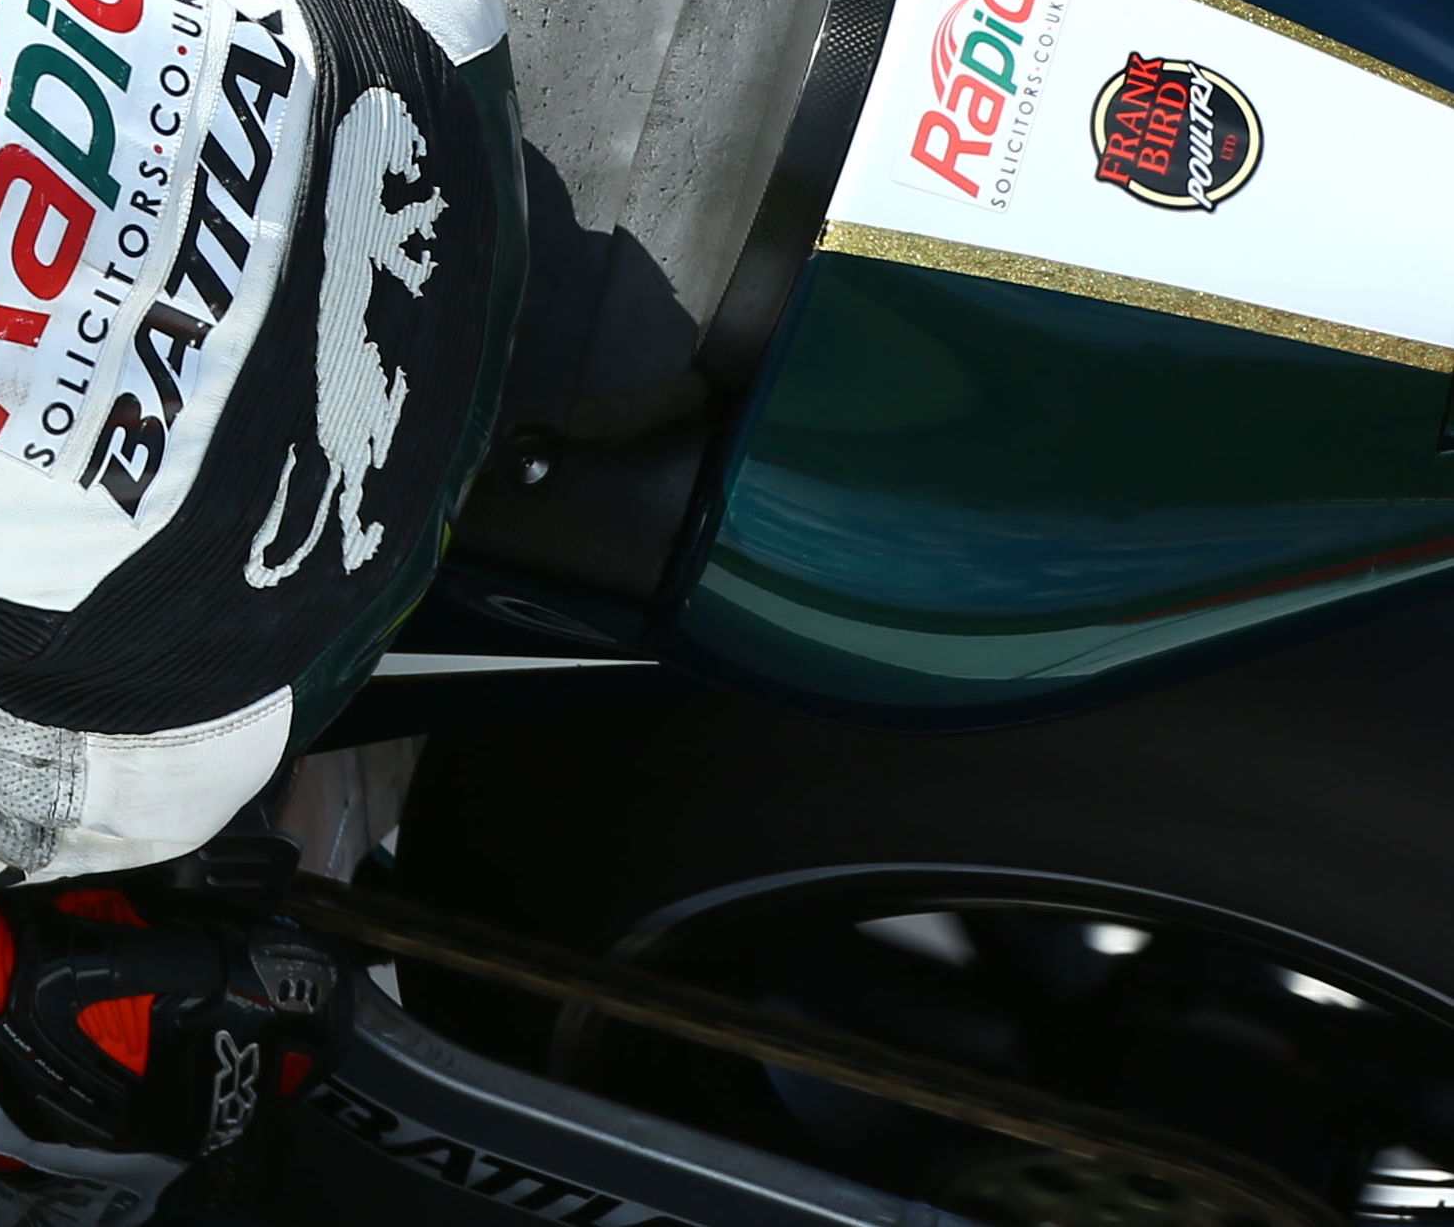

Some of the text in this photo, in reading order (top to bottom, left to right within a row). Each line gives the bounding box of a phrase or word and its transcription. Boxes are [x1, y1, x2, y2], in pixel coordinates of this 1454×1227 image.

[1098, 53, 1165, 185] FRANK
[1137, 80, 1190, 177] BIRD
[1186, 62, 1215, 211] POULTRY
[1220, 133, 1240, 162] LTD
